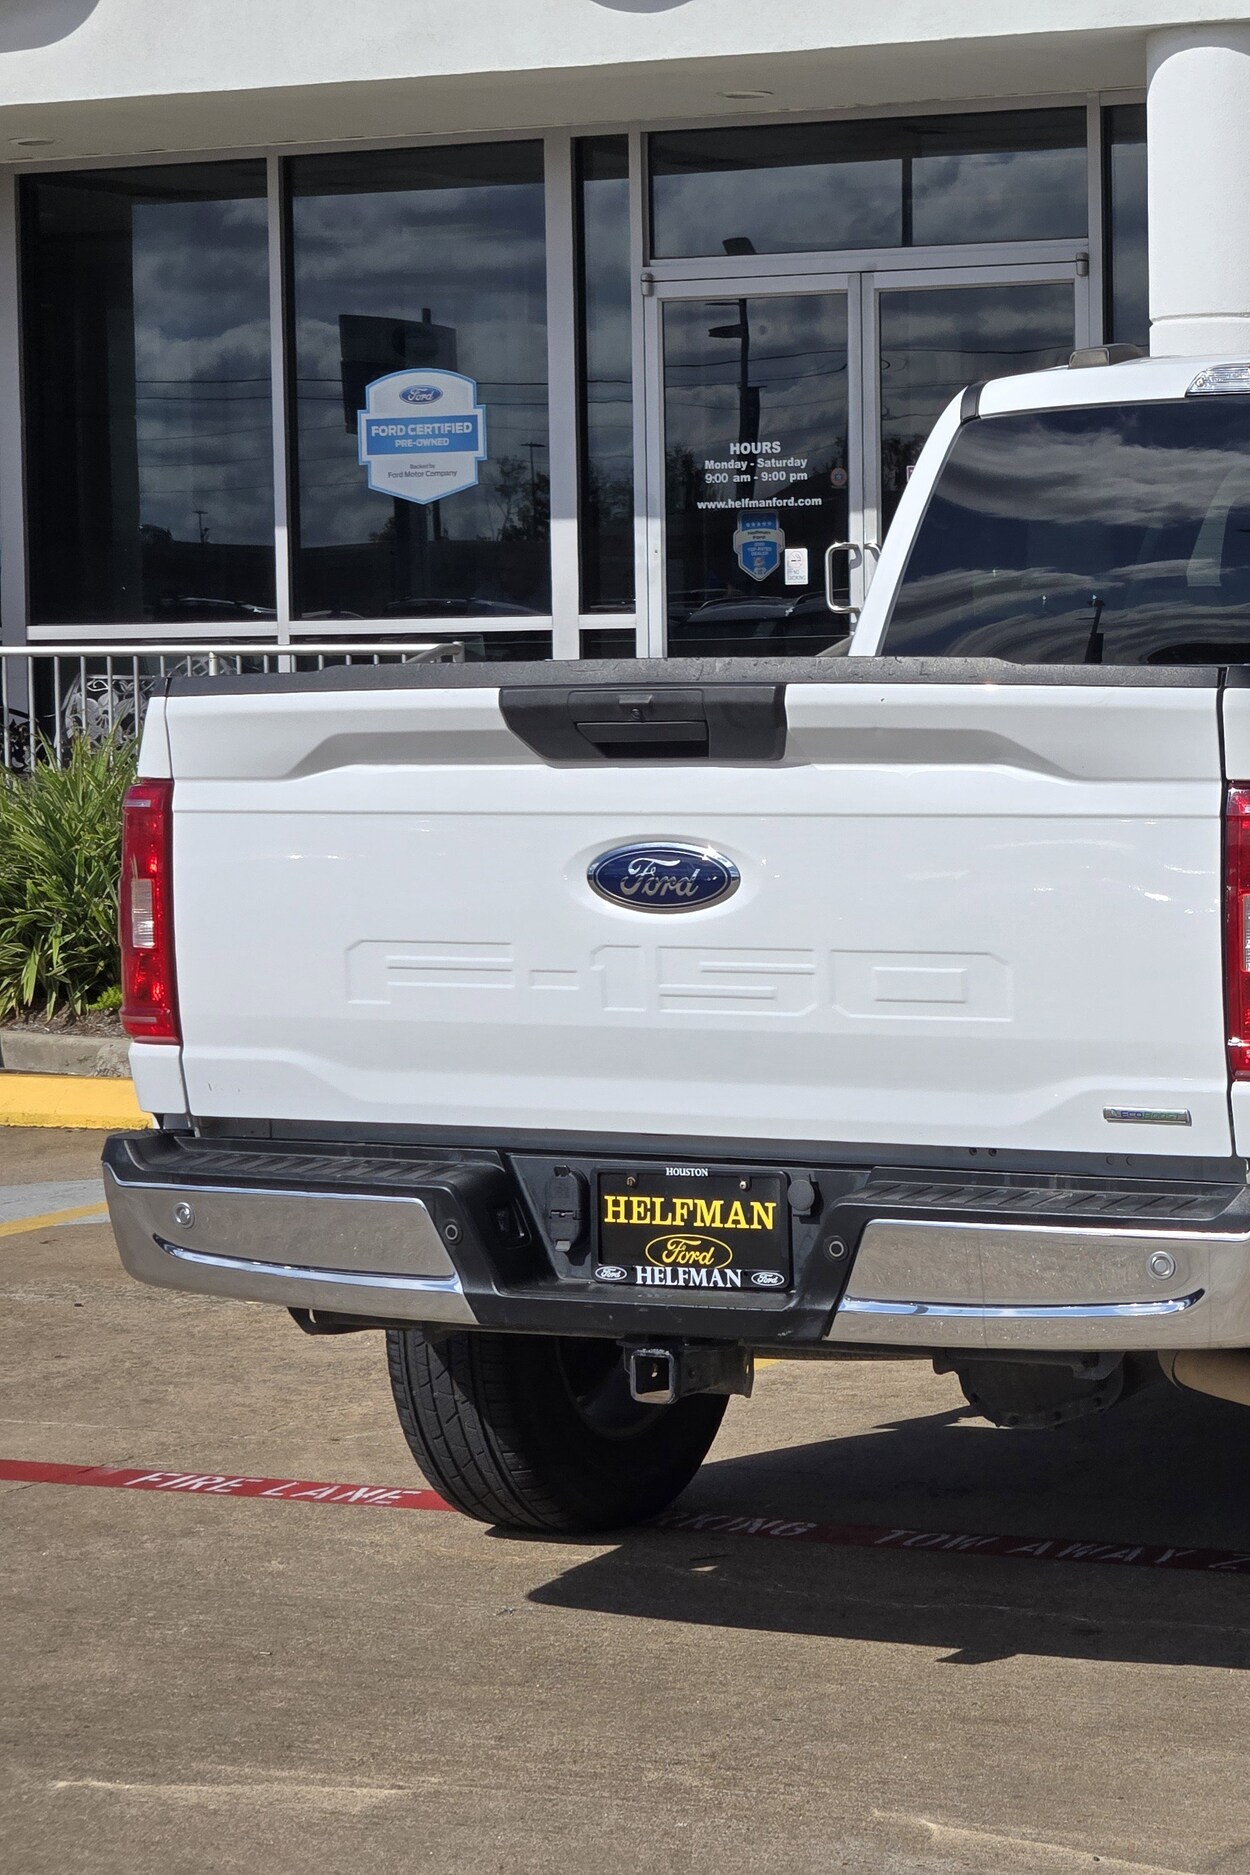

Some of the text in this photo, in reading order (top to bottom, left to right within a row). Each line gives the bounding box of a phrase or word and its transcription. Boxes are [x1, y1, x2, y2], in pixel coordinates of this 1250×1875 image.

[371, 422, 473, 436] FORD CERTIFIED
[395, 438, 450, 447] PRE-OWNED
[729, 441, 781, 455] HOURS
[704, 459, 748, 470] Monday
[756, 457, 808, 469] Saturday
[387, 471, 403, 479] Ford
[705, 473, 729, 484] 9:00
[732, 473, 751, 483] am
[761, 471, 787, 482] 9:00
[789, 472, 808, 483] pm
[697, 496, 823, 510] www.helfmanford.com
[620, 857, 701, 897] Ford
[346, 939, 1013, 1023] F-150
[665, 1167, 709, 1178] HOUSTON
[603, 1195, 777, 1230] HELFMAN
[661, 1238, 715, 1266] Ford
[635, 1265, 742, 1288] HELFMAN
[124, 1472, 422, 1505] FIRE LANE
[873, 1529, 1001, 1551] TOW
[1005, 1540, 1198, 1566] AWAY
